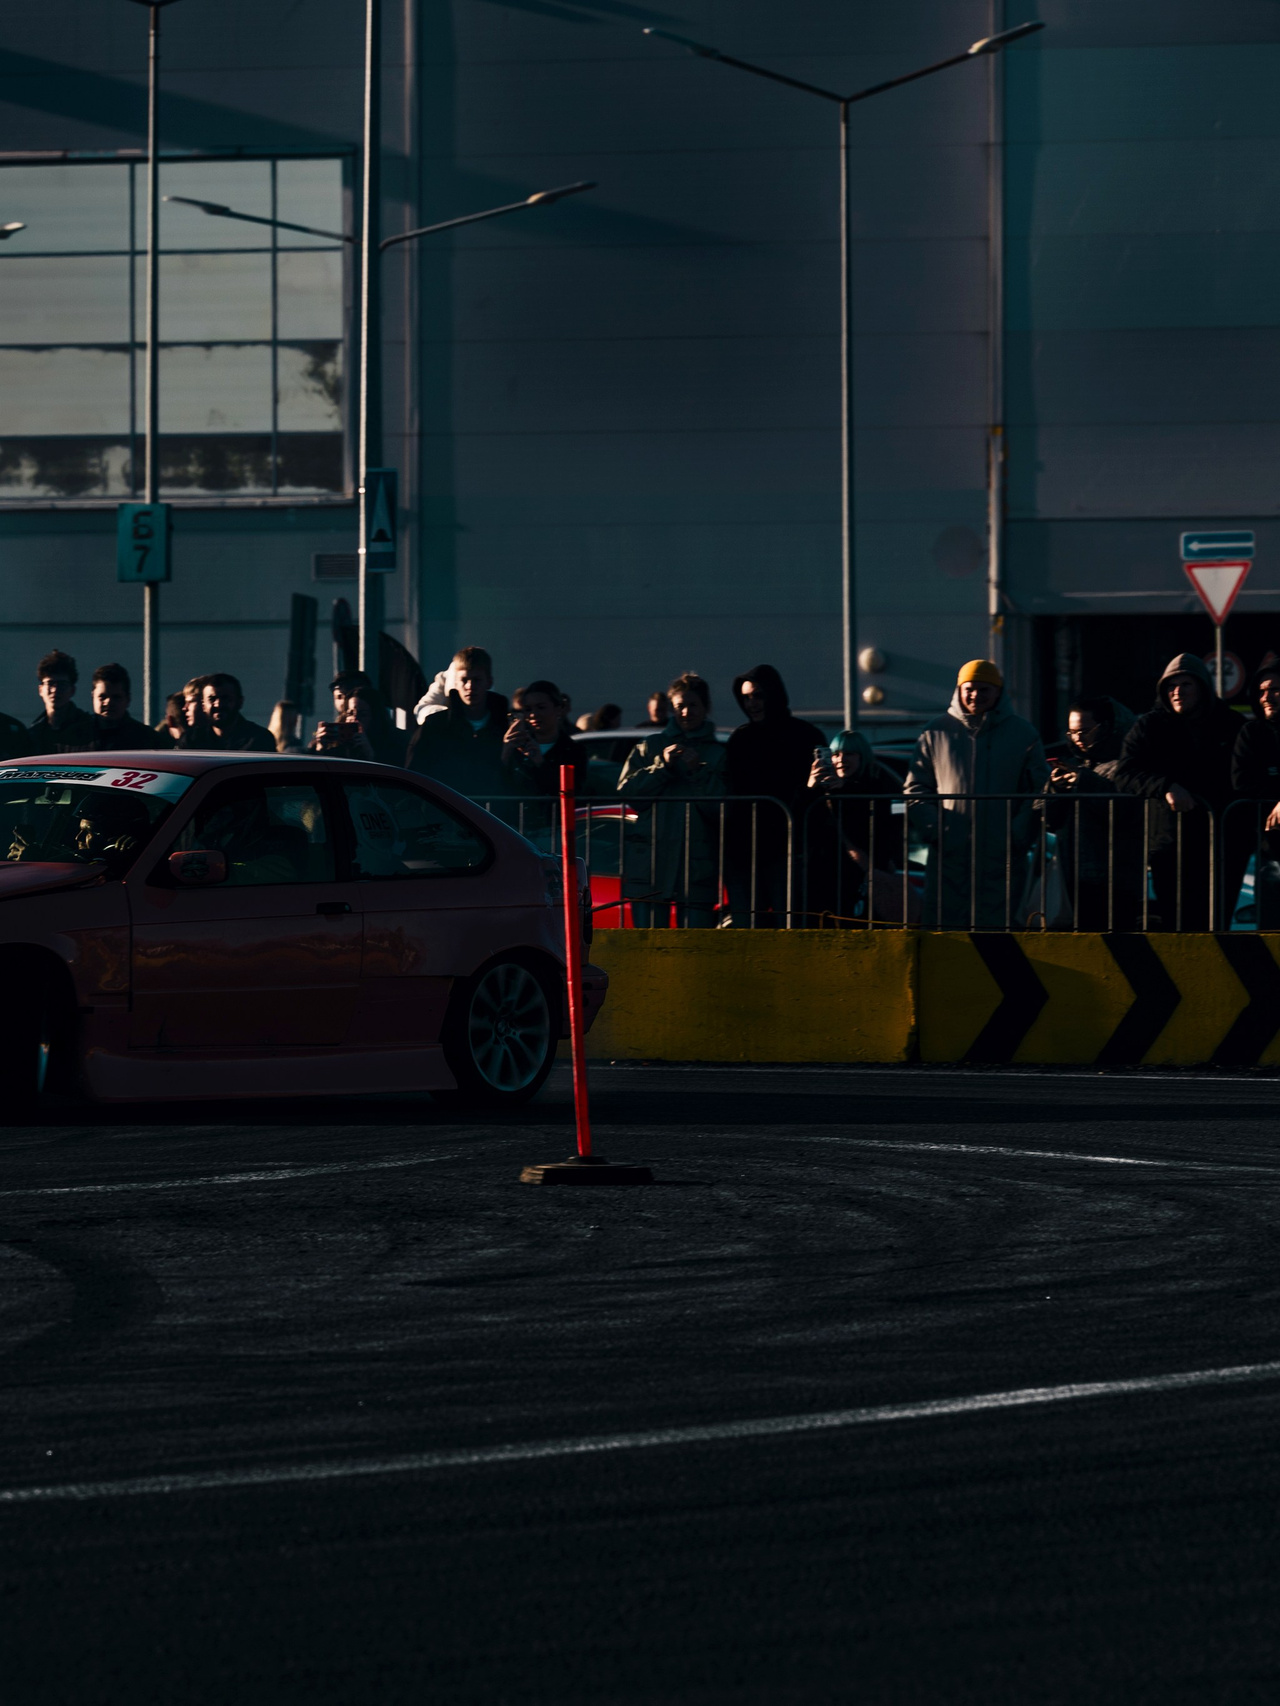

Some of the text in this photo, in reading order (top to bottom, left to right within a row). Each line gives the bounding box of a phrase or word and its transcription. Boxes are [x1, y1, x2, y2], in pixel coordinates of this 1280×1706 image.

[133, 511, 153, 539] 6
[133, 545, 151, 573] 7
[110, 771, 158, 789] 32
[359, 813, 390, 830] ONE
